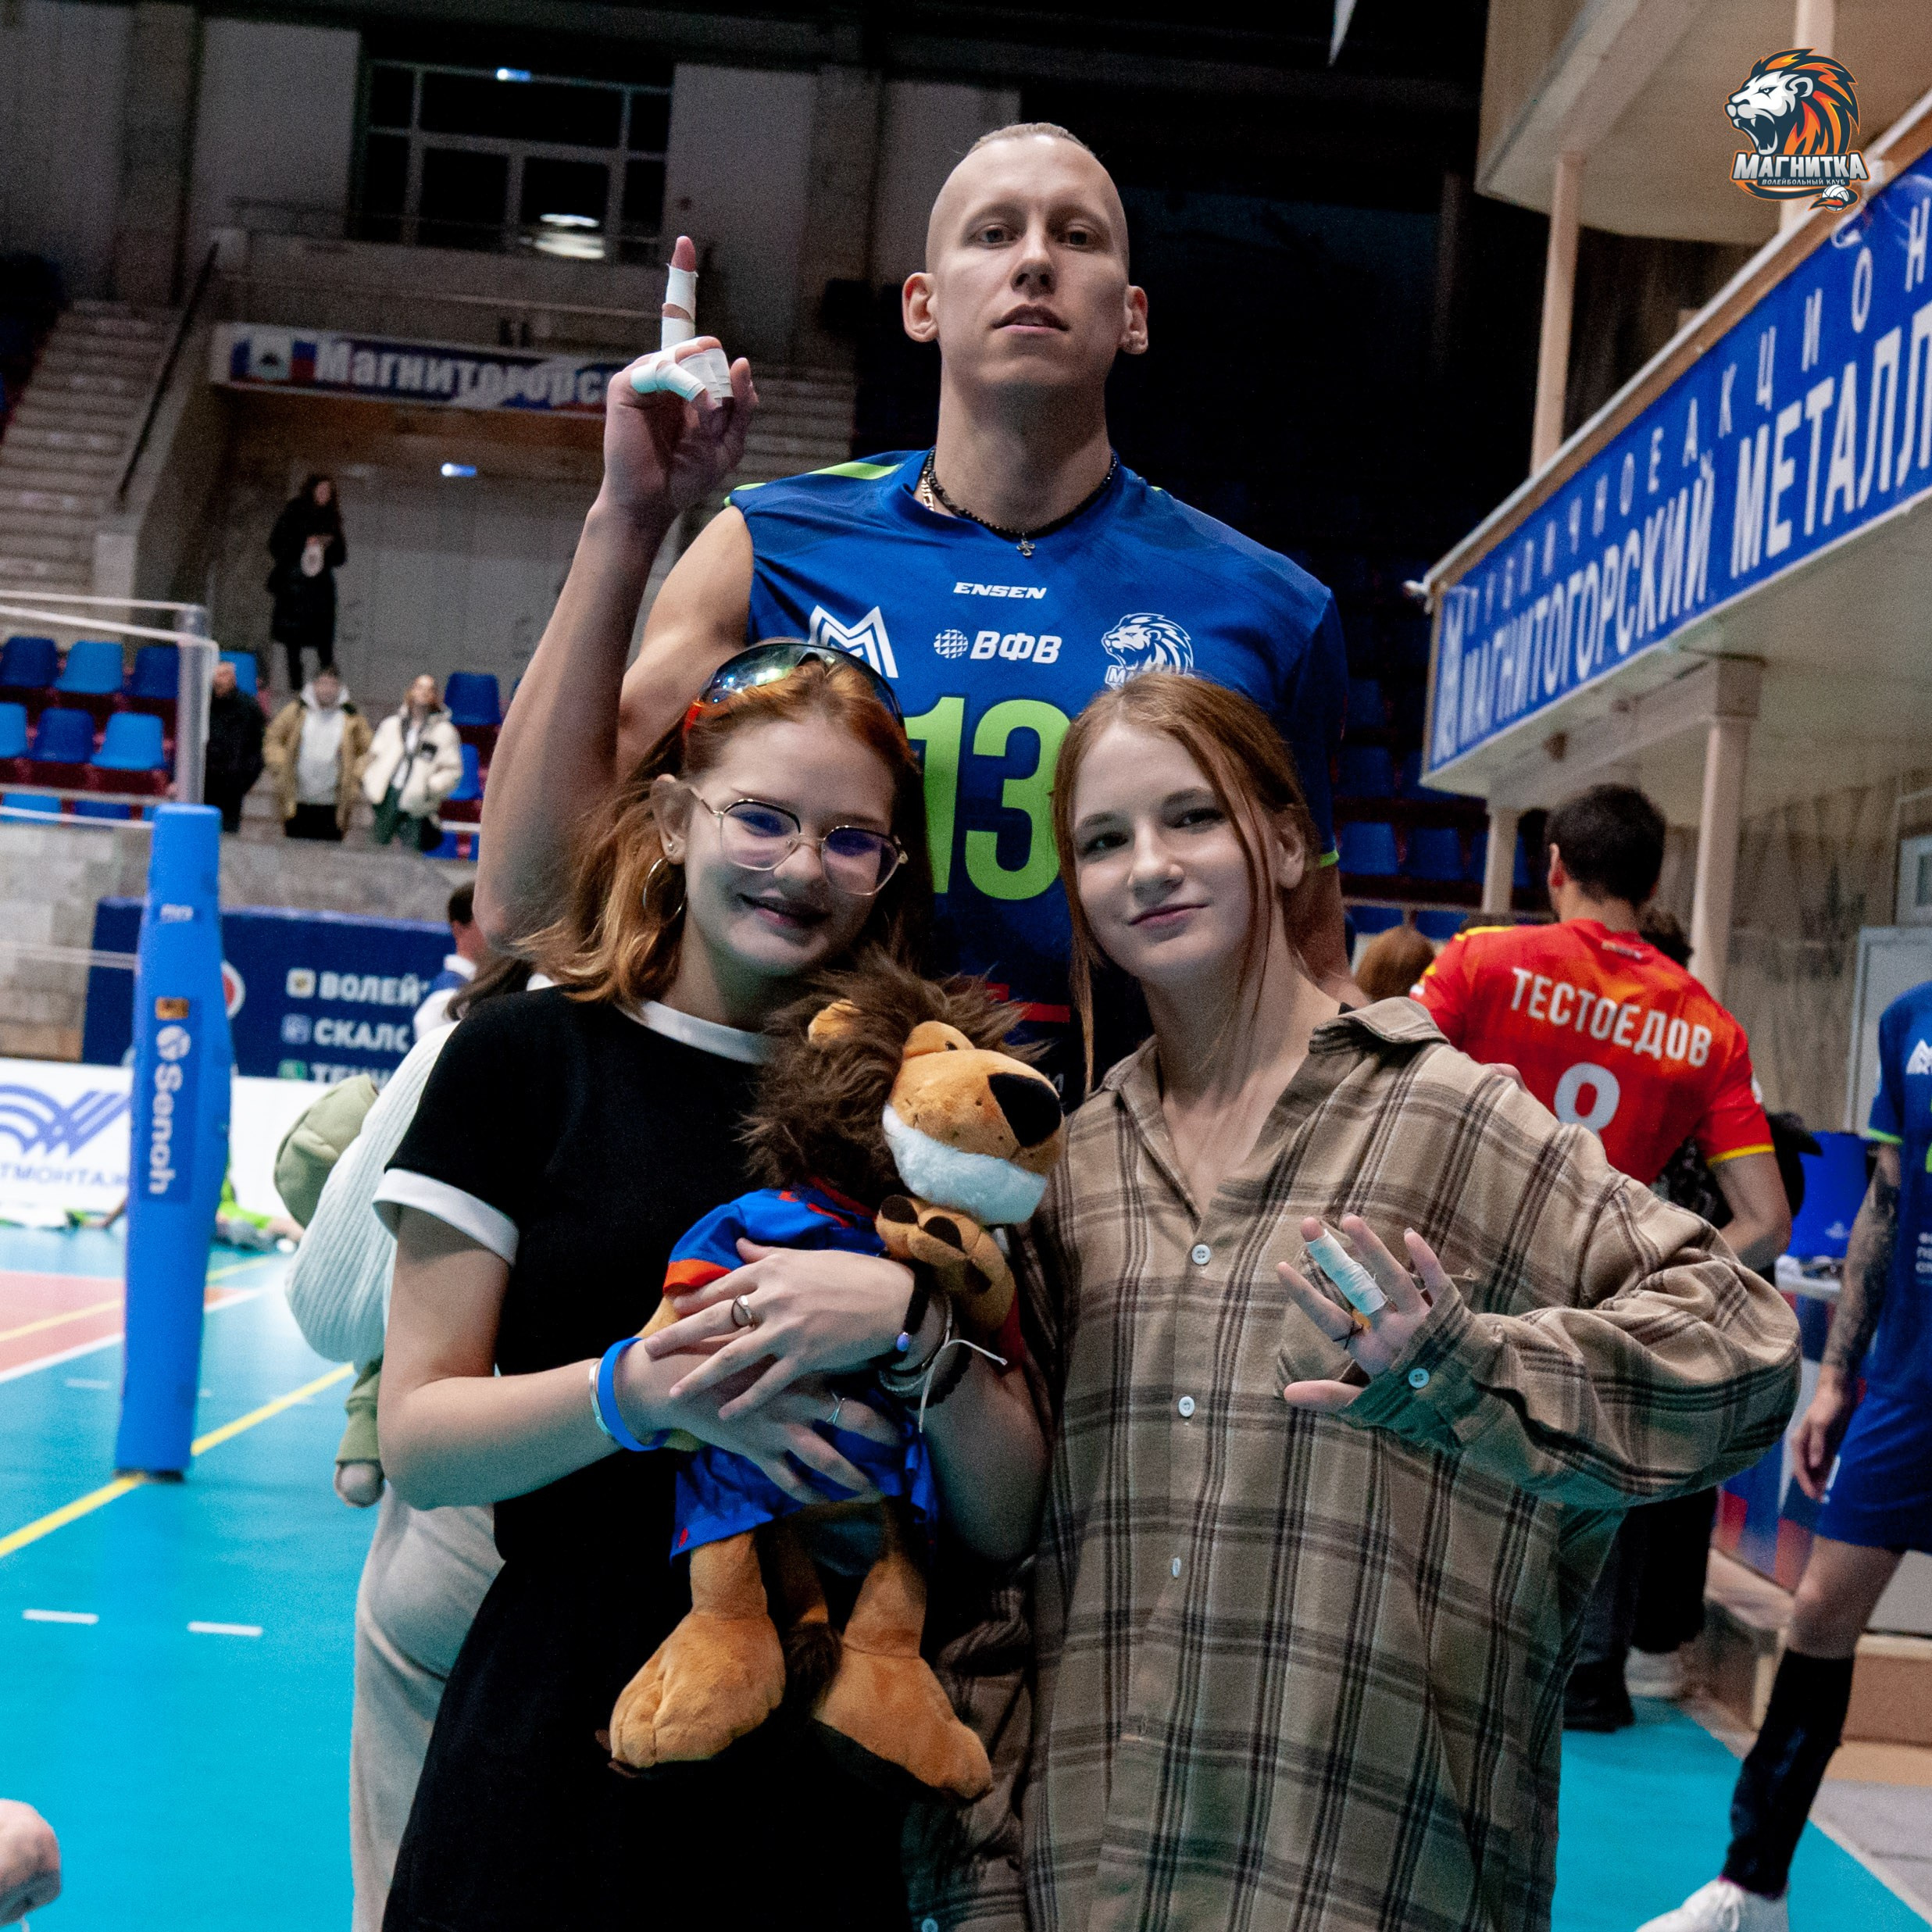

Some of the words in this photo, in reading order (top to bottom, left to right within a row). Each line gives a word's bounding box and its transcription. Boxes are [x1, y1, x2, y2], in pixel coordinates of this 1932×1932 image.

[315, 339, 612, 408] Магнитогорс
[953, 581, 1047, 599] ENSEN
[1432, 449, 1716, 764] МАГНИТОГОРСКИЙ
[970, 630, 1063, 664] ВФВ
[904, 696, 1071, 900] 13
[319, 970, 429, 1006] ВОЛЕЙ
[1510, 966, 1712, 1068] ТЕСТОЕДОВ
[148, 1063, 184, 1195] Senoh
